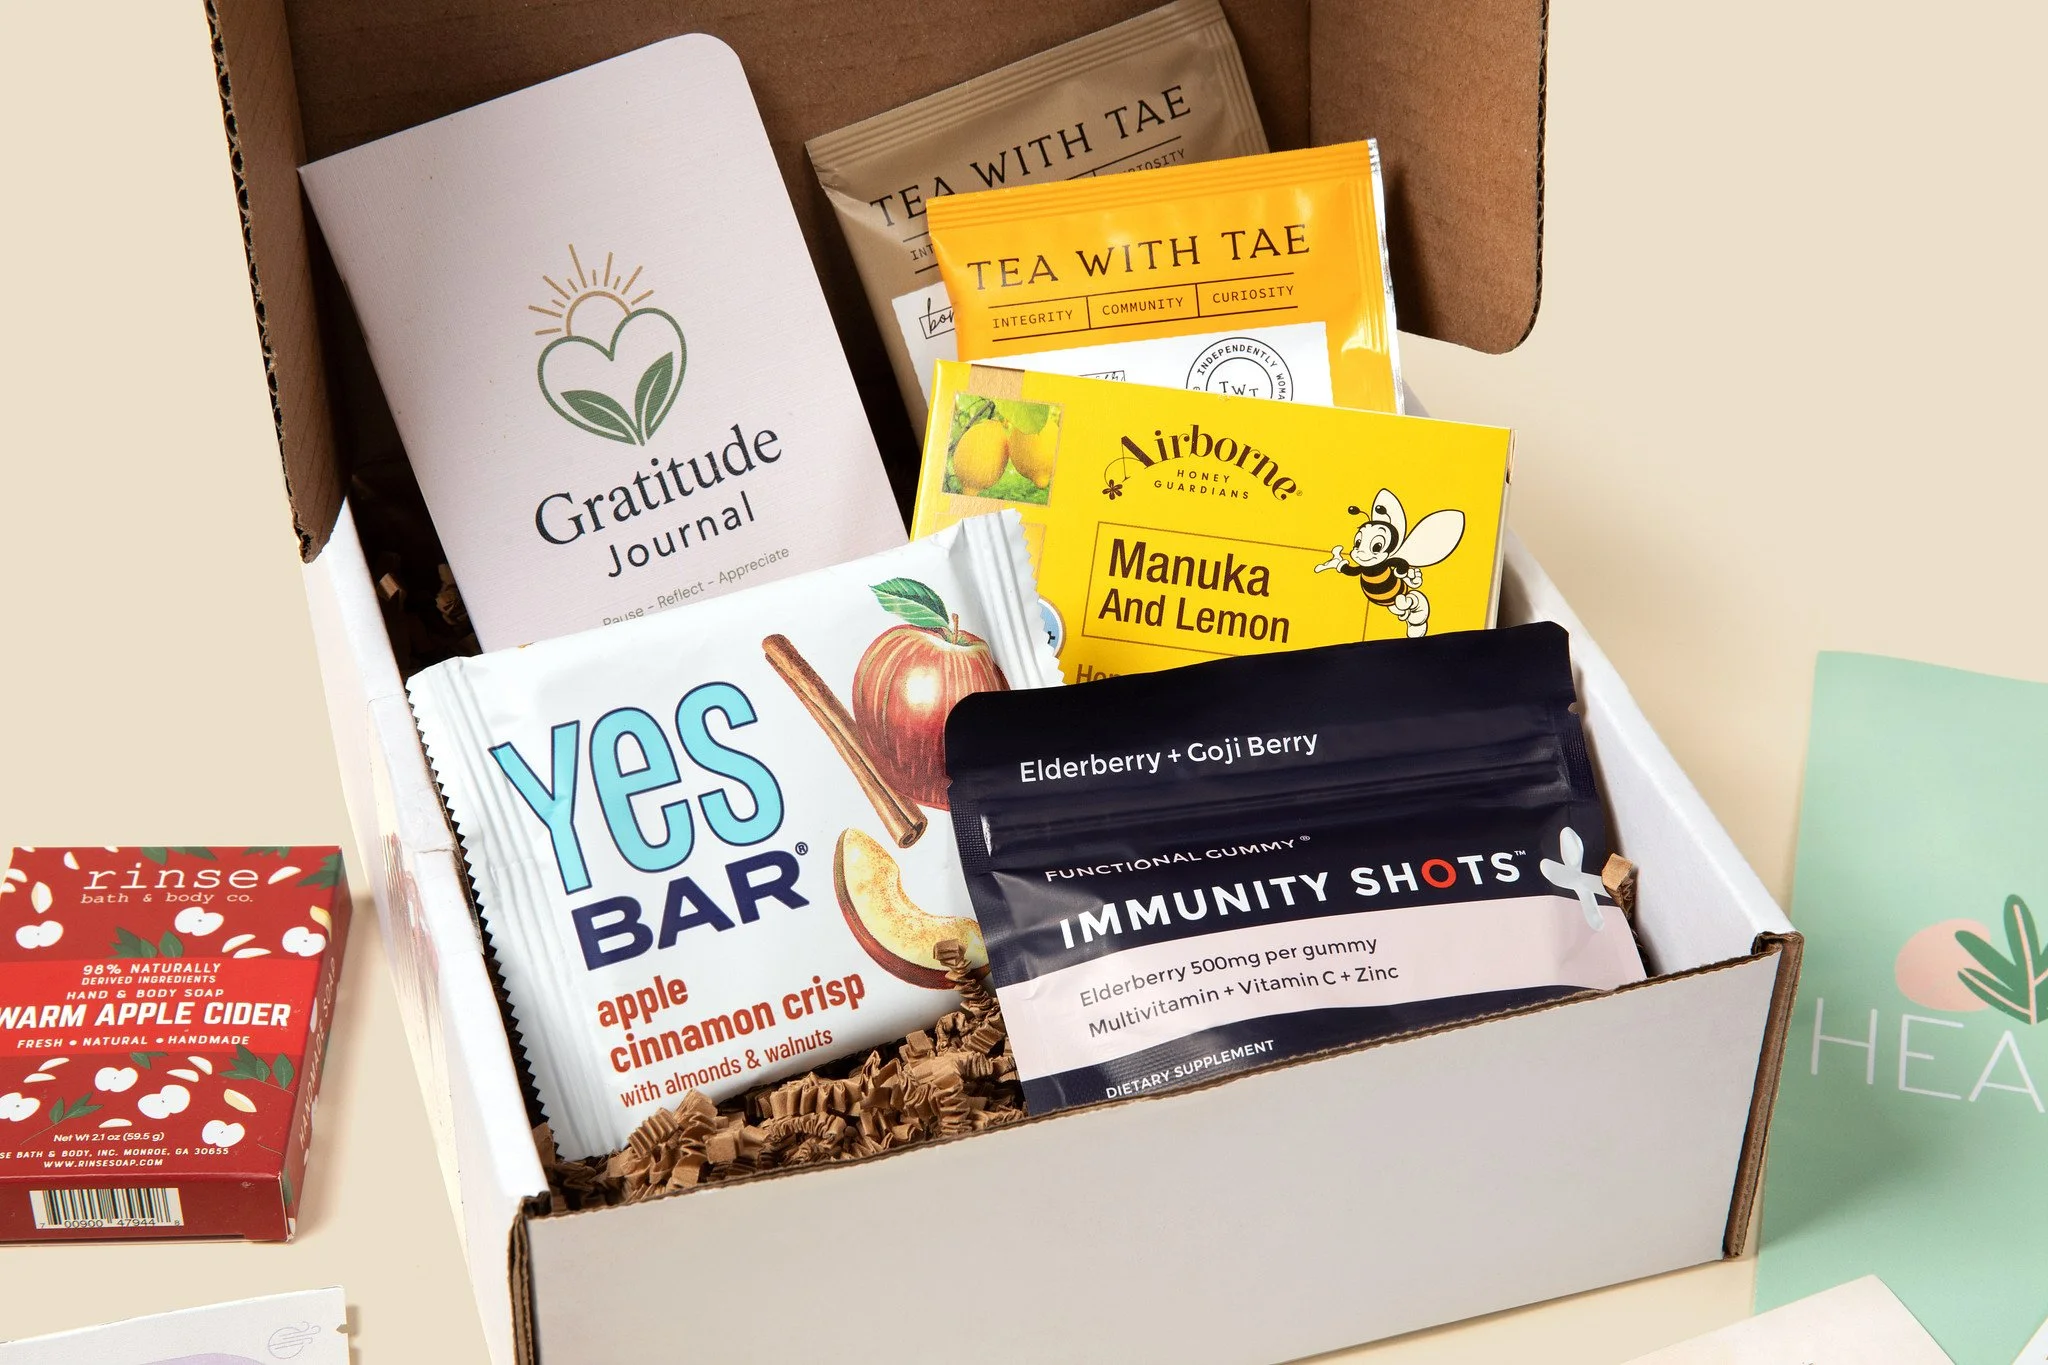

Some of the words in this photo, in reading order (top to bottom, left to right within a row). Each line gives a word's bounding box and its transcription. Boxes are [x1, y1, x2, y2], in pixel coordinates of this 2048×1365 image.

[870, 176, 955, 227] TEA
[969, 122, 1093, 188] WITH
[1104, 85, 1191, 139] TAE
[967, 254, 1058, 291] TEA
[1075, 235, 1200, 277] WITH
[1220, 223, 1310, 260] TAE
[992, 309, 1074, 330] INTEGRITY
[1102, 297, 1184, 316] COMMUNITY
[1212, 285, 1294, 304] CURIOSITY
[1196, 344, 1278, 376] INDEPENDENTLY
[1275, 373, 1287, 400] WOMA
[1219, 380, 1259, 398] TWT
[534, 424, 783, 546] Gratitude
[1154, 480, 1249, 500] GUARDIANS
[1176, 469, 1230, 484] HONEY
[607, 490, 756, 579] Journal
[657, 580, 705, 609] Reflect
[719, 548, 790, 584] Appreciate
[1108, 538, 1270, 598] Manuka
[1098, 588, 1166, 627] And
[1176, 597, 1290, 644] Lemon
[1020, 751, 1161, 783] Elderberry
[1187, 737, 1242, 765] Goji
[1247, 733, 1318, 757] Berry
[83, 862, 260, 890] rinse
[1044, 851, 1202, 883] FUNCTIONAL
[80, 893, 129, 904] bath
[143, 893, 153, 904] &
[165, 892, 214, 905] body
[226, 893, 254, 903] co.
[1059, 871, 1329, 950] IMMUNITY
[81, 975, 133, 986] DERIVED
[137, 974, 216, 985] INGREDIENTS
[83, 964, 122, 976] 98%
[130, 963, 222, 974] NATURALLY
[1079, 964, 1186, 1007] Elderberry
[1190, 953, 1262, 976] 500mg
[1265, 946, 1298, 965] per
[1302, 937, 1378, 960] gummy
[0, 1003, 88, 1030] WARM
[94, 1001, 196, 1027] APPLE
[203, 1002, 292, 1028] CIDER
[66, 990, 108, 1000] HAND
[116, 989, 127, 999] &
[136, 989, 178, 999] BODY
[184, 988, 225, 998] SOAP
[597, 975, 689, 1030] apple
[1088, 987, 1219, 1038] Multivitamin
[1238, 969, 1319, 996] Vitamin
[1322, 970, 1337, 986] C
[1354, 963, 1400, 983] Zinc
[17, 1038, 63, 1050] FRESH
[82, 1036, 148, 1047] NATURAL
[168, 1035, 251, 1046] HANDMADE
[610, 1001, 776, 1073] cinnamon
[782, 972, 866, 1020] crisp
[620, 1079, 661, 1108] with
[665, 1056, 742, 1095] almonds
[745, 1049, 762, 1070] &
[764, 1028, 834, 1063] walnuts
[1105, 1070, 1170, 1099] DIETARY
[1173, 1039, 1275, 1078] SUPPLEMENT
[16, 1151, 43, 1159] BATH
[97, 1149, 119, 1157] INC.
[194, 1147, 229, 1155] 30655
[53, 1134, 73, 1142] Net
[75, 1134, 90, 1142] Wt
[92, 1133, 105, 1141] 2.1
[123, 1132, 151, 1142] (59.5
[152, 1132, 165, 1142] g)
[43, 1158, 163, 1168] WWW.RINSESOAP.COM
[64, 1219, 104, 1229] 00900
[116, 1218, 156, 1228] 47944
